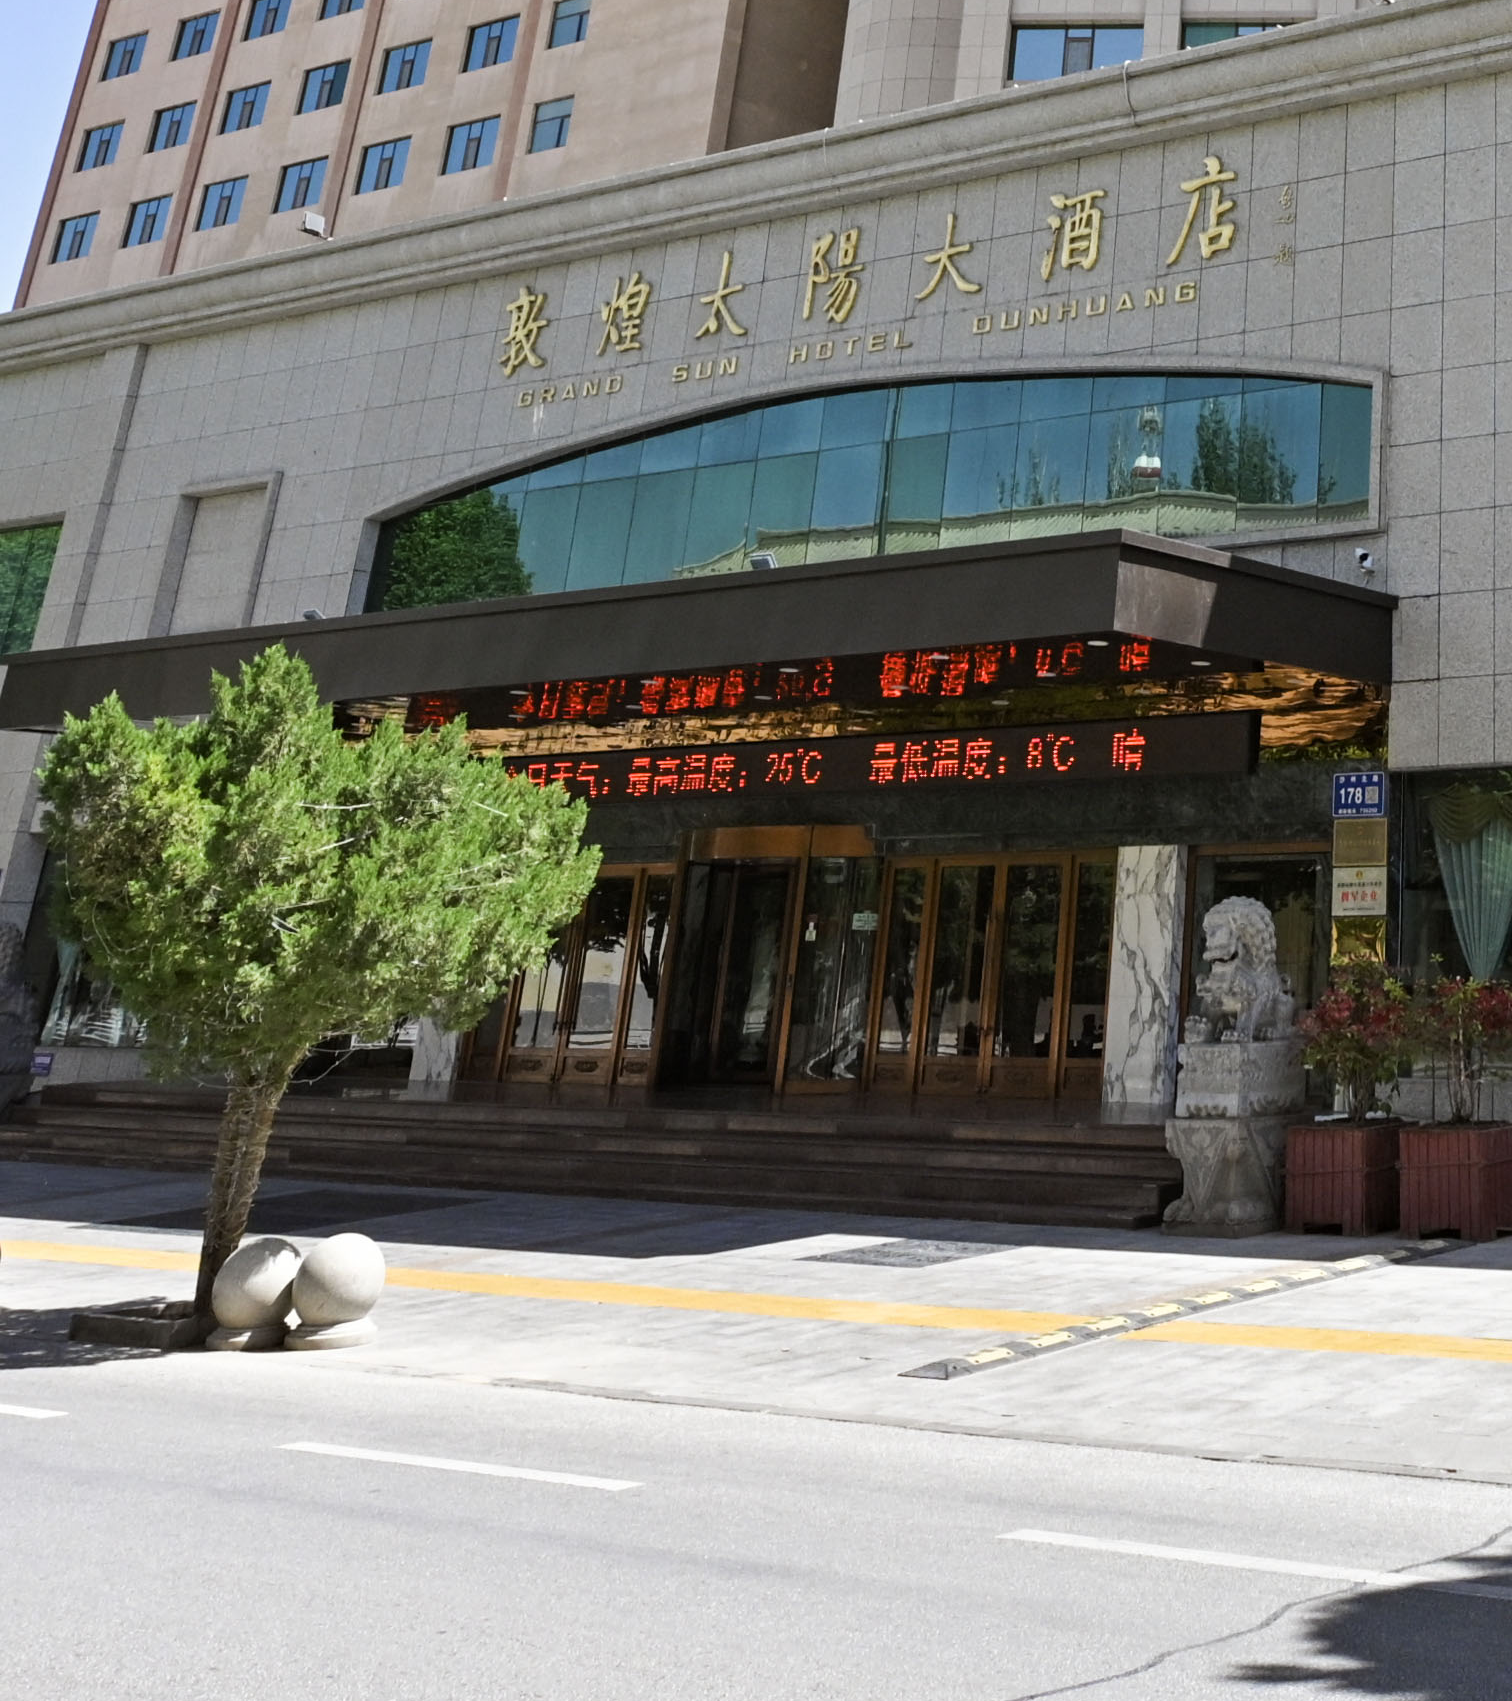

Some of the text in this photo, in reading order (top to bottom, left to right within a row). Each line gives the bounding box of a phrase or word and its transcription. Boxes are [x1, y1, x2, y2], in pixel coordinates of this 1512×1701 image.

[498, 154, 1238, 378] 敦煌太陽大酒店
[517, 282, 1199, 408] GRAND SUN HOTEL DUNHUANG
[1339, 787, 1363, 804] 178
